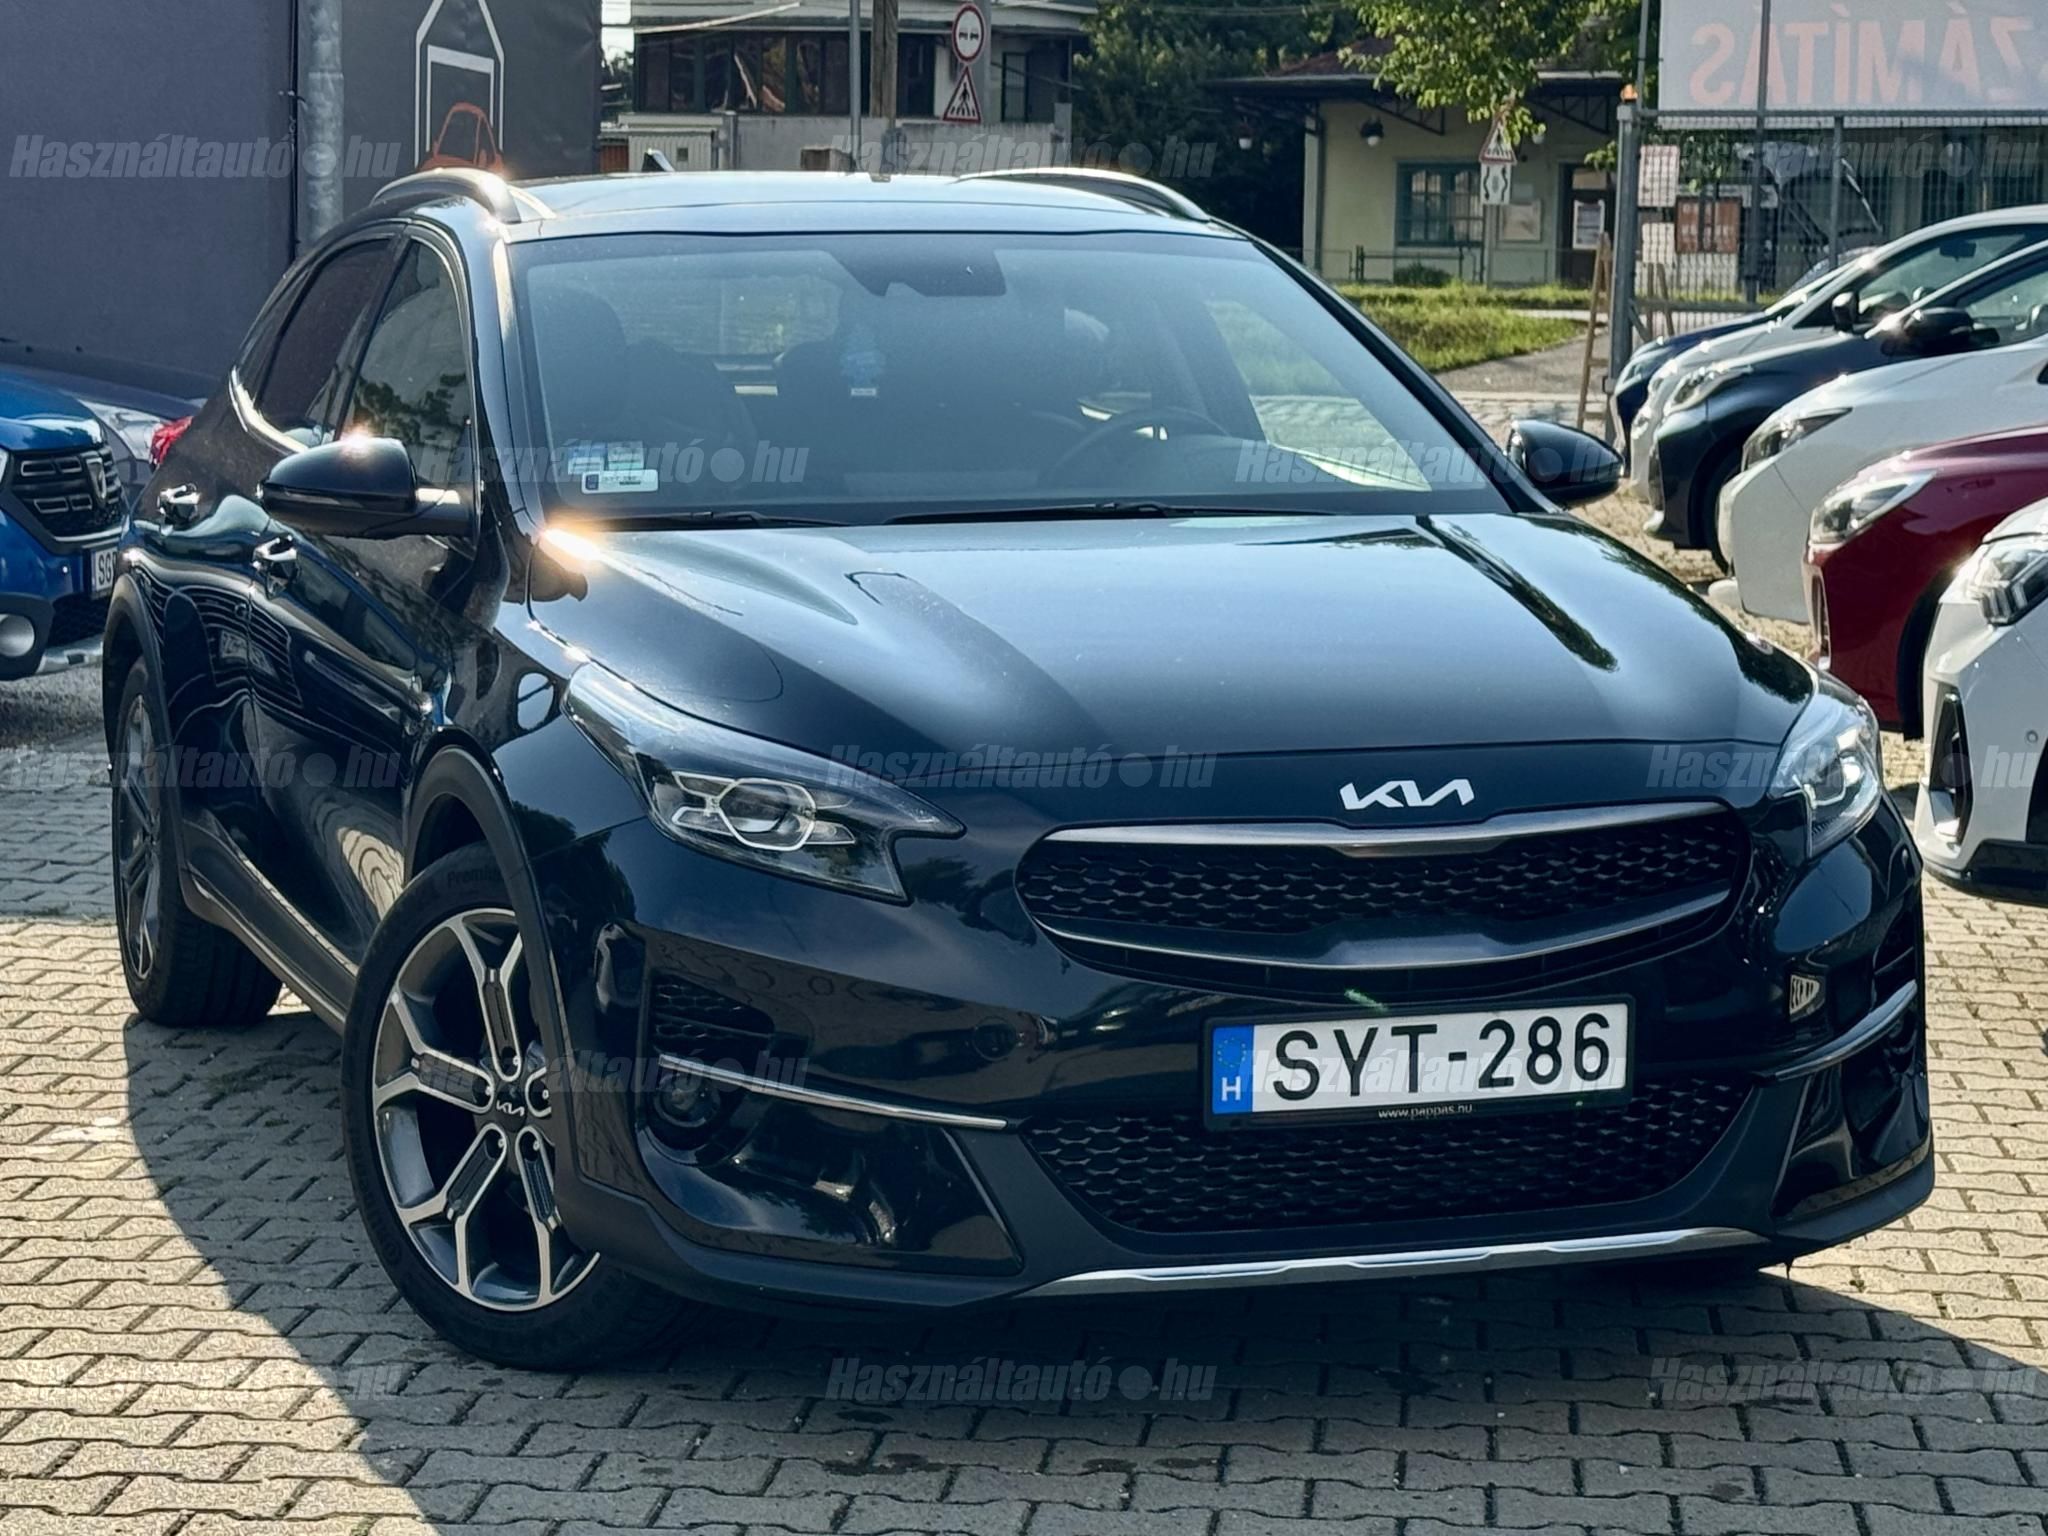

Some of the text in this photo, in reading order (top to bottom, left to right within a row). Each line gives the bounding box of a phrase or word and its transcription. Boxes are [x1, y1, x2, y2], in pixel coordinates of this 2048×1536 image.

[1339, 778, 1475, 810] KIA
[1273, 1012, 1611, 1102] SYT-286
[1221, 1076, 1242, 1102] H
